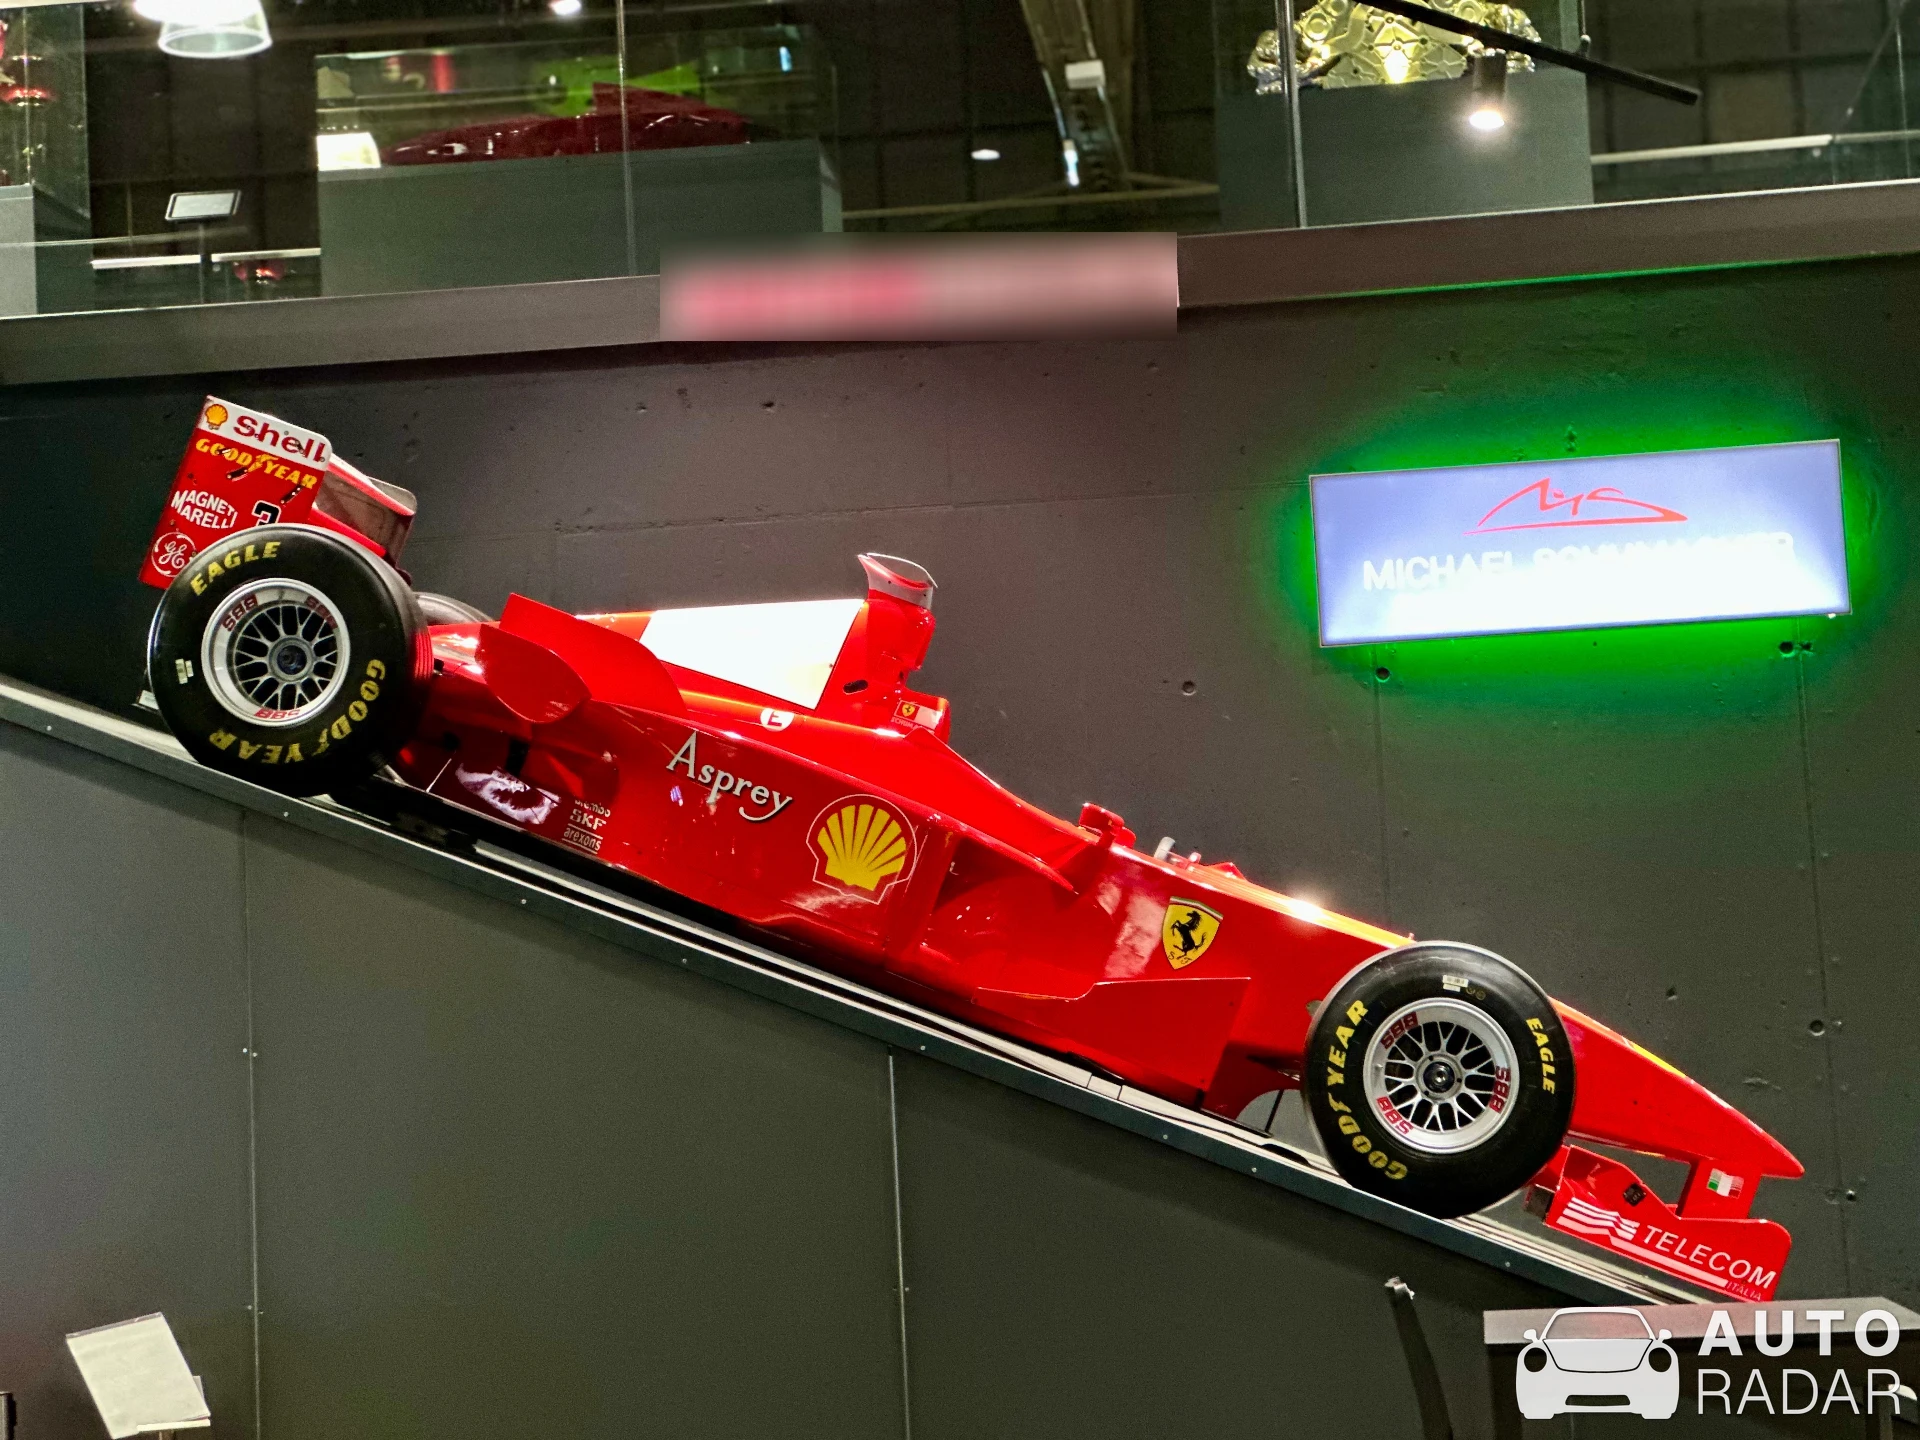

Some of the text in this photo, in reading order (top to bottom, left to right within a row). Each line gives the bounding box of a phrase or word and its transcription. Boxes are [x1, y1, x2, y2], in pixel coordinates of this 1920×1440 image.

[233, 414, 326, 463] Shell
[171, 490, 238, 519] MAGNETI
[171, 497, 238, 529] MARELLI
[190, 541, 281, 597] EAGLE
[666, 730, 794, 822] Asprey
[563, 827, 602, 851] arexons
[570, 808, 607, 830] SKF
[1379, 1011, 1419, 1051] BBS
[1525, 1017, 1556, 1095] EAGLE
[1489, 1066, 1512, 1114] BBS
[1376, 1096, 1414, 1135] BBS
[1642, 1224, 1777, 1290] TELECOM
